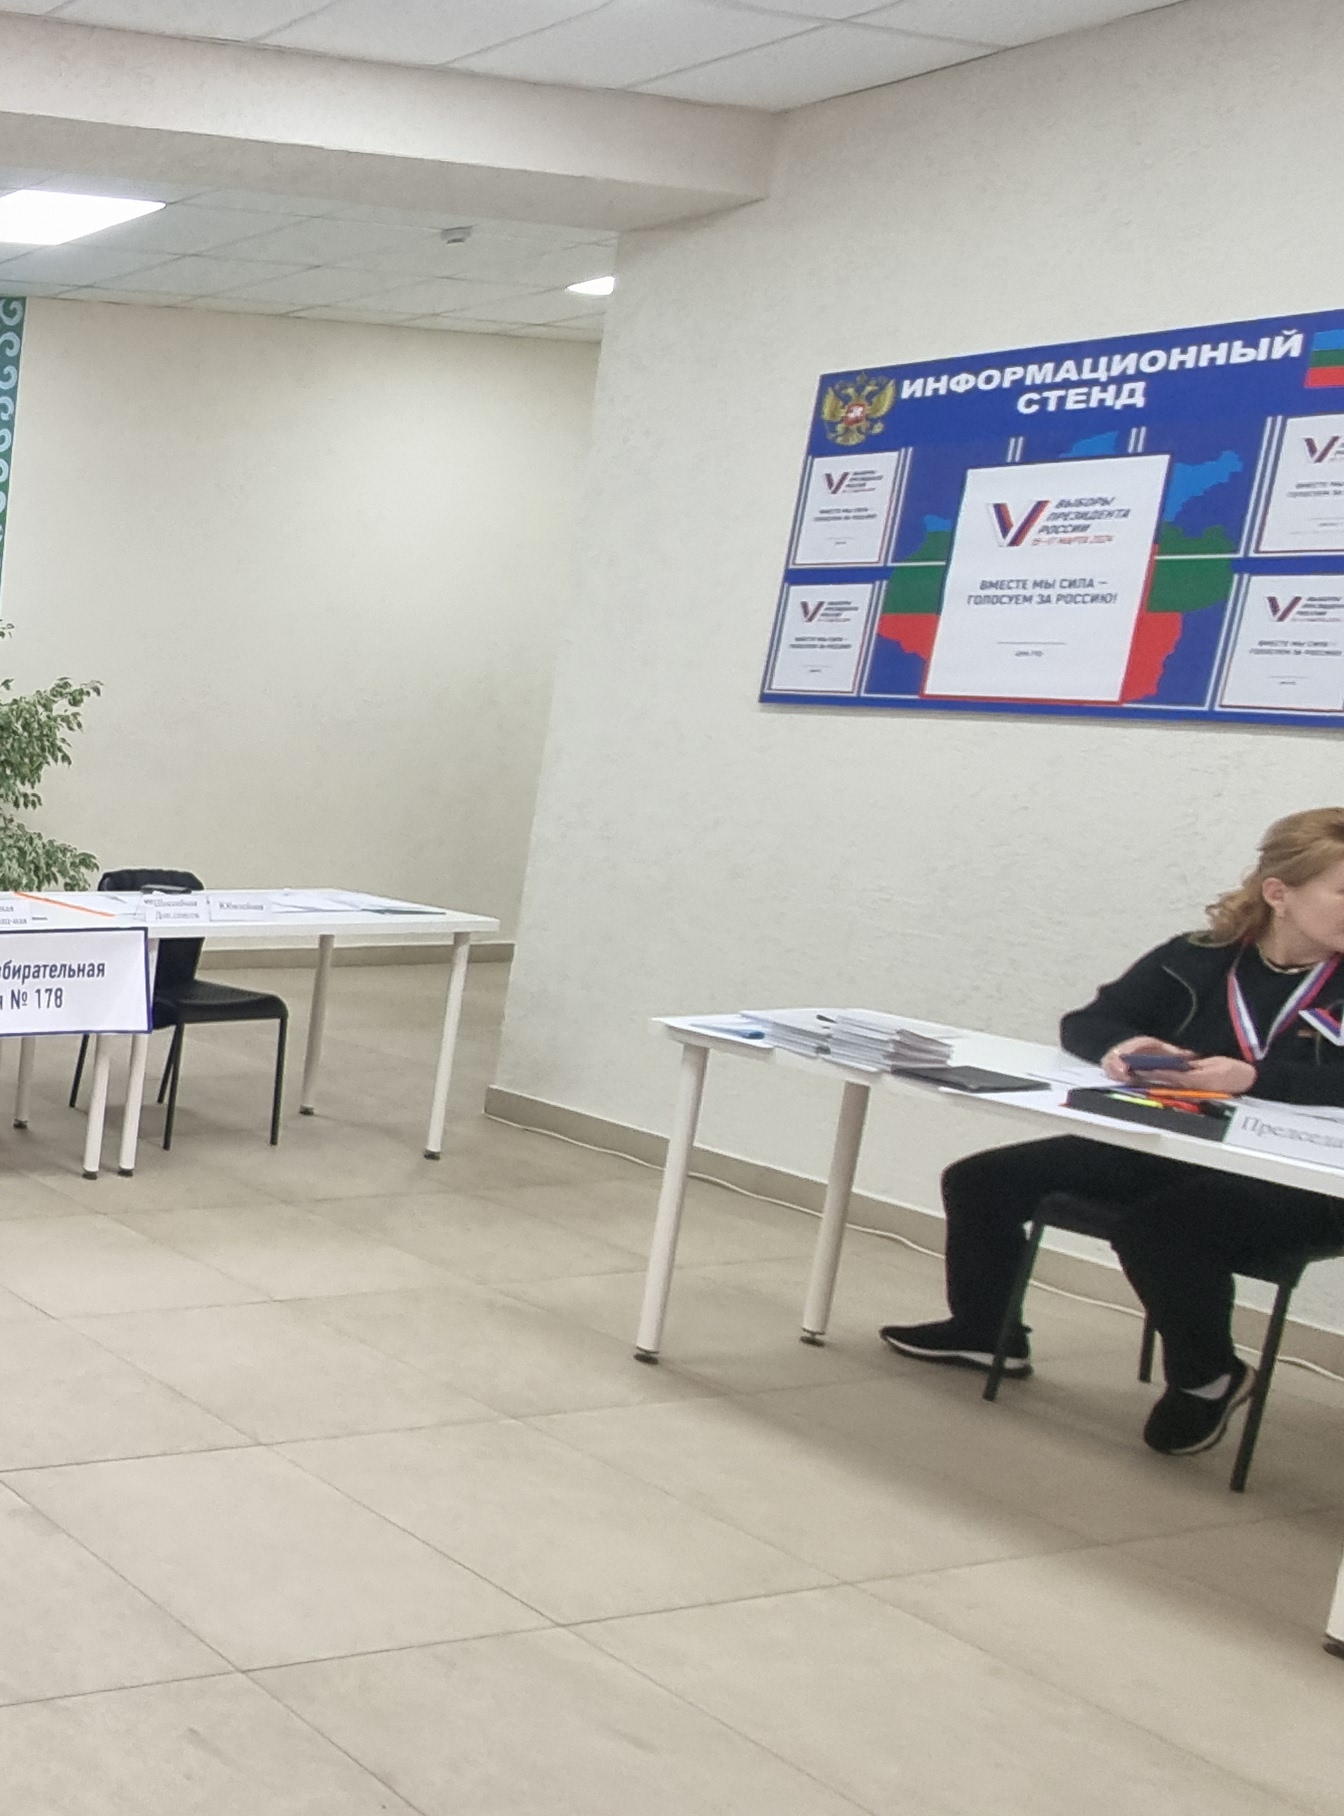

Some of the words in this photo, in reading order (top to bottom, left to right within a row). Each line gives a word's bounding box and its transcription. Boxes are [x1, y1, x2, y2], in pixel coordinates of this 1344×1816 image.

[900, 329, 1304, 399] ИНФОРМАЦИОННЫЙ
[1016, 381, 1147, 414] СТЕНД
[979, 579, 1028, 590] ВМЕСТЕ
[1032, 579, 1056, 590] МЫ
[1059, 578, 1095, 589] СИЛА
[967, 594, 1033, 605] ГОЛОСУЕМ
[1037, 594, 1052, 605] ЗА
[10, 988, 28, 1010] №
[35, 987, 64, 1010] 178
